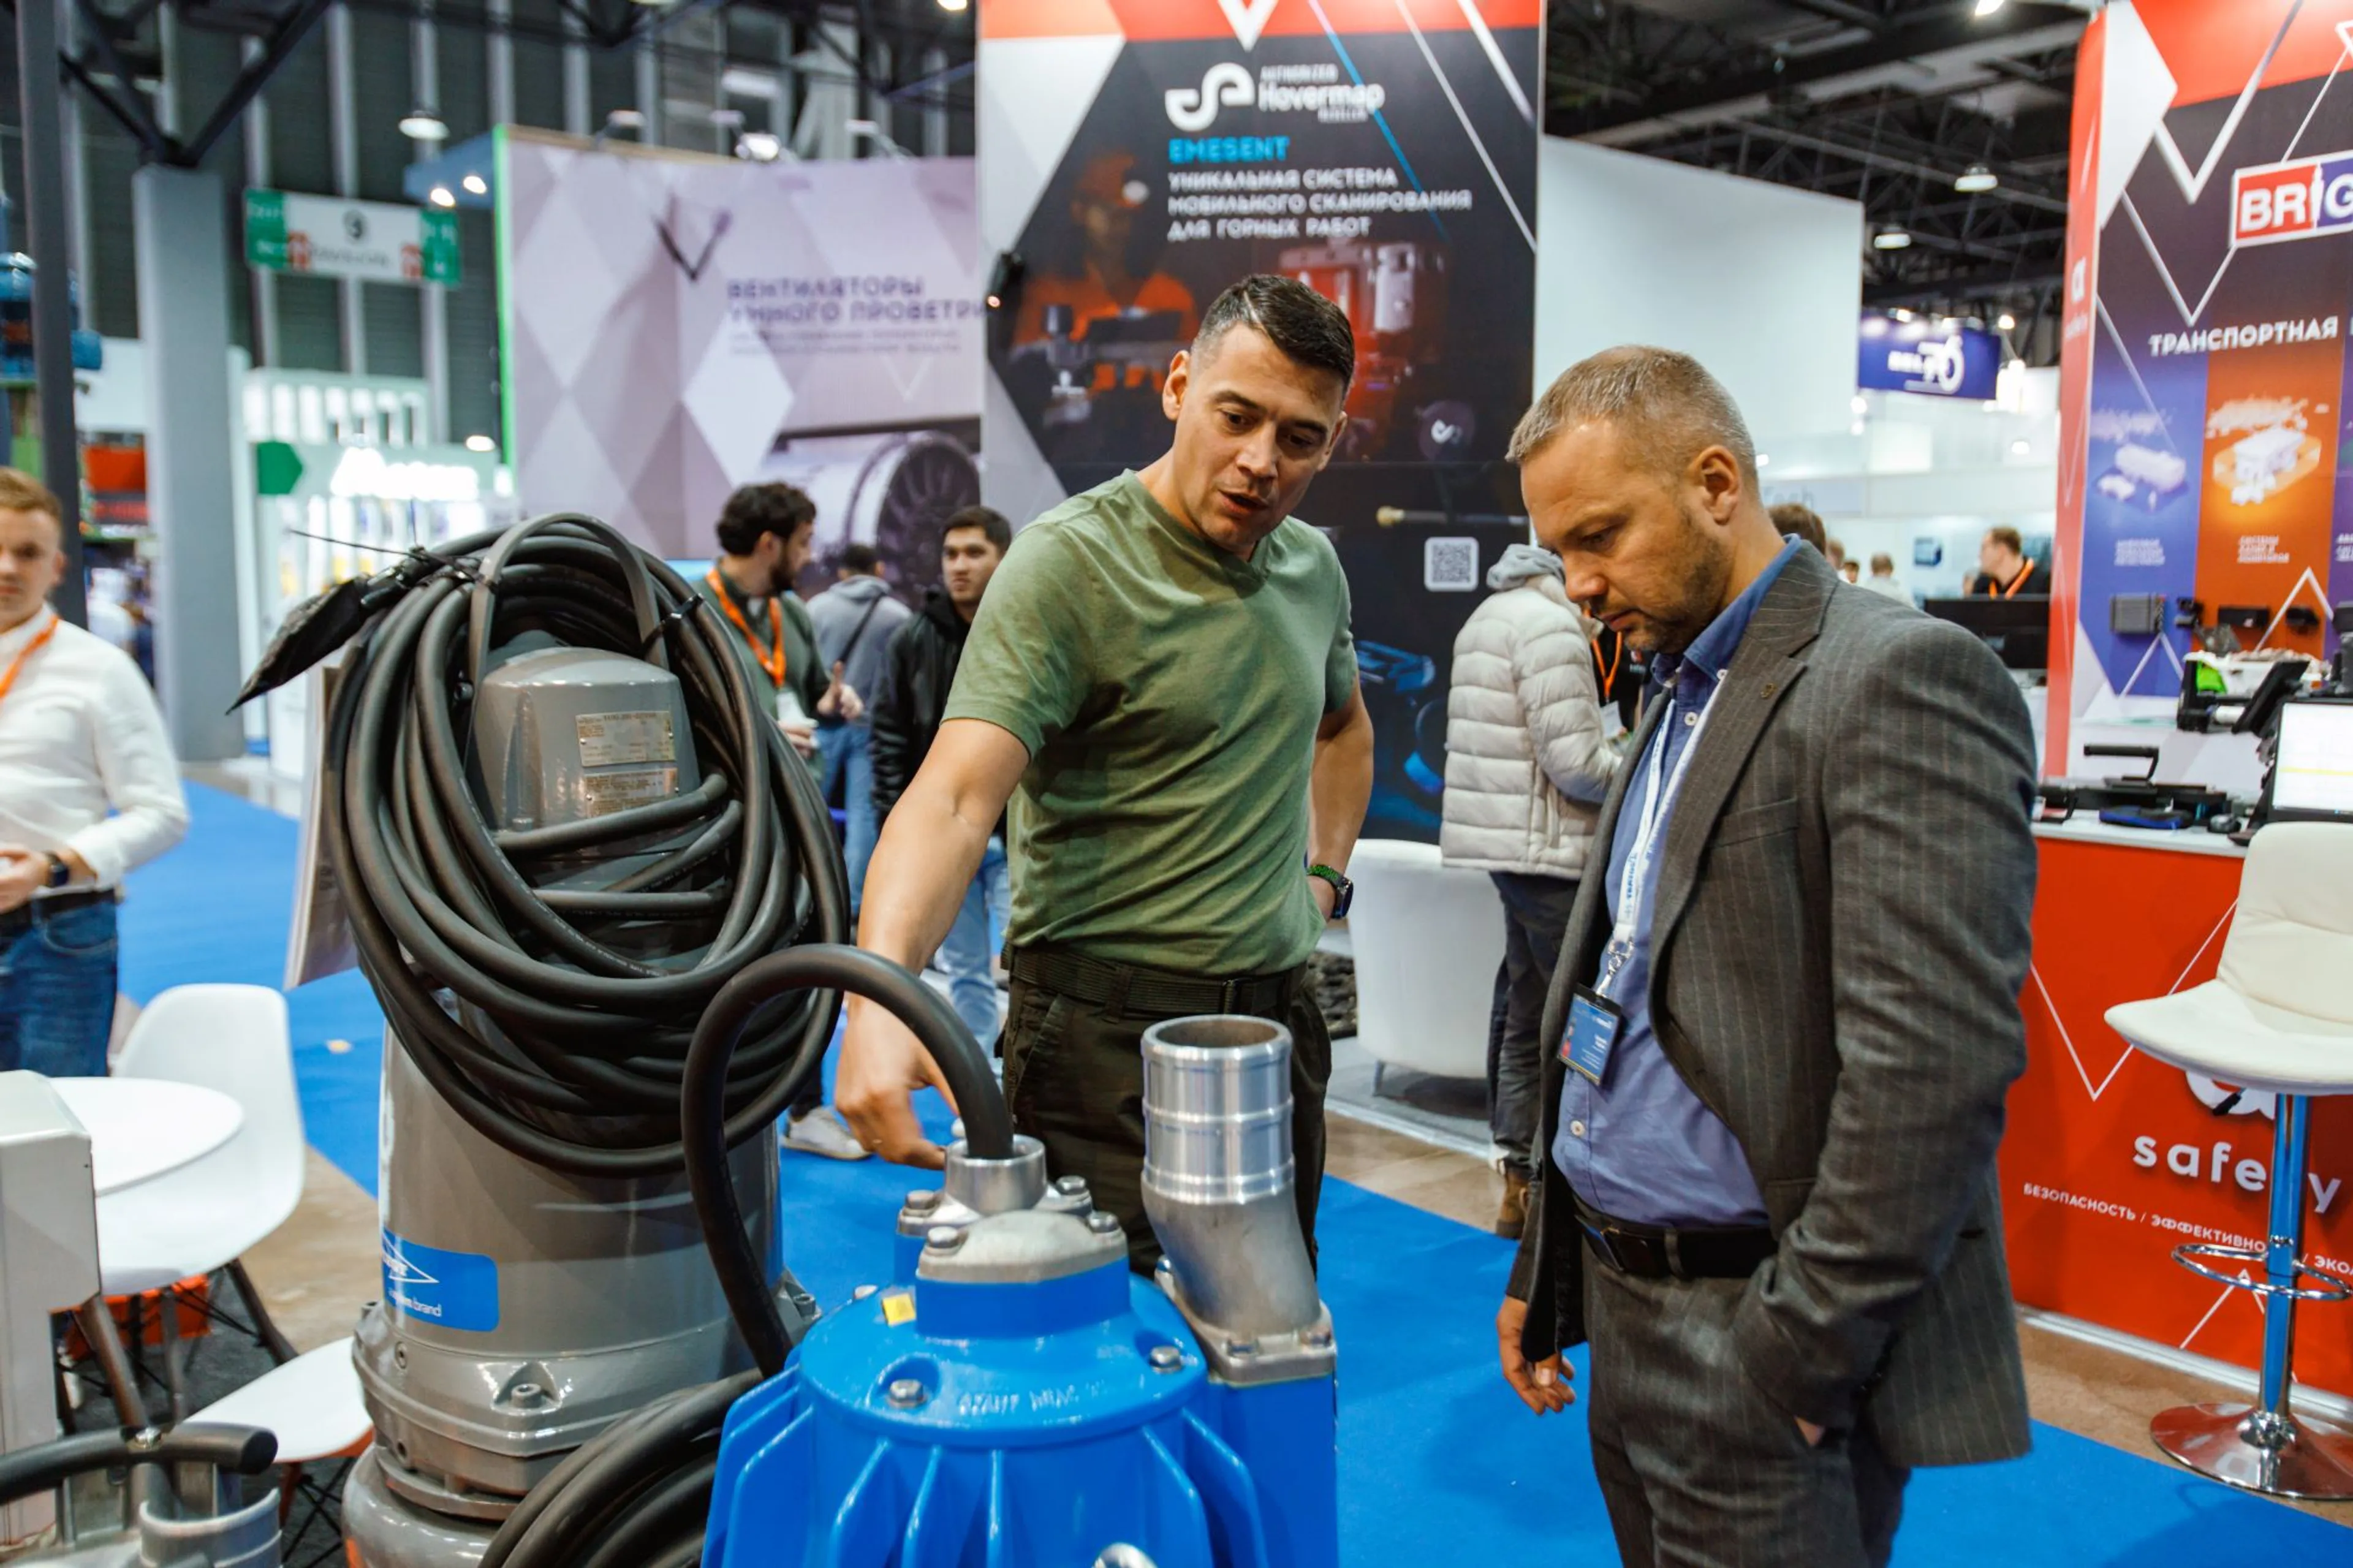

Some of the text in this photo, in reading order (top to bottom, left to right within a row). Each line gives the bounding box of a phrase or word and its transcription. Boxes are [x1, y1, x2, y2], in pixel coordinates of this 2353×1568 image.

[1257, 81, 1385, 115] Hovermap
[1169, 135, 1290, 165] EMESENT
[1168, 167, 1398, 192] УНИКАЛЬНАЯ СИСТЕМА
[1168, 189, 1472, 216] МОБИЛЬНОГО СКАНИРОВАНИЯ
[1167, 216, 1371, 243] ДЛЯ ГОРНЫХ РАБОТ
[2148, 316, 2338, 357] ТРАНСПОРТНАЯ
[2133, 1135, 2342, 1214] safey
[2023, 1182, 2136, 1221] БЕЗОПАСНОСТЬ
[2151, 1213, 2267, 1253] ЭФФЕКТИВНО
